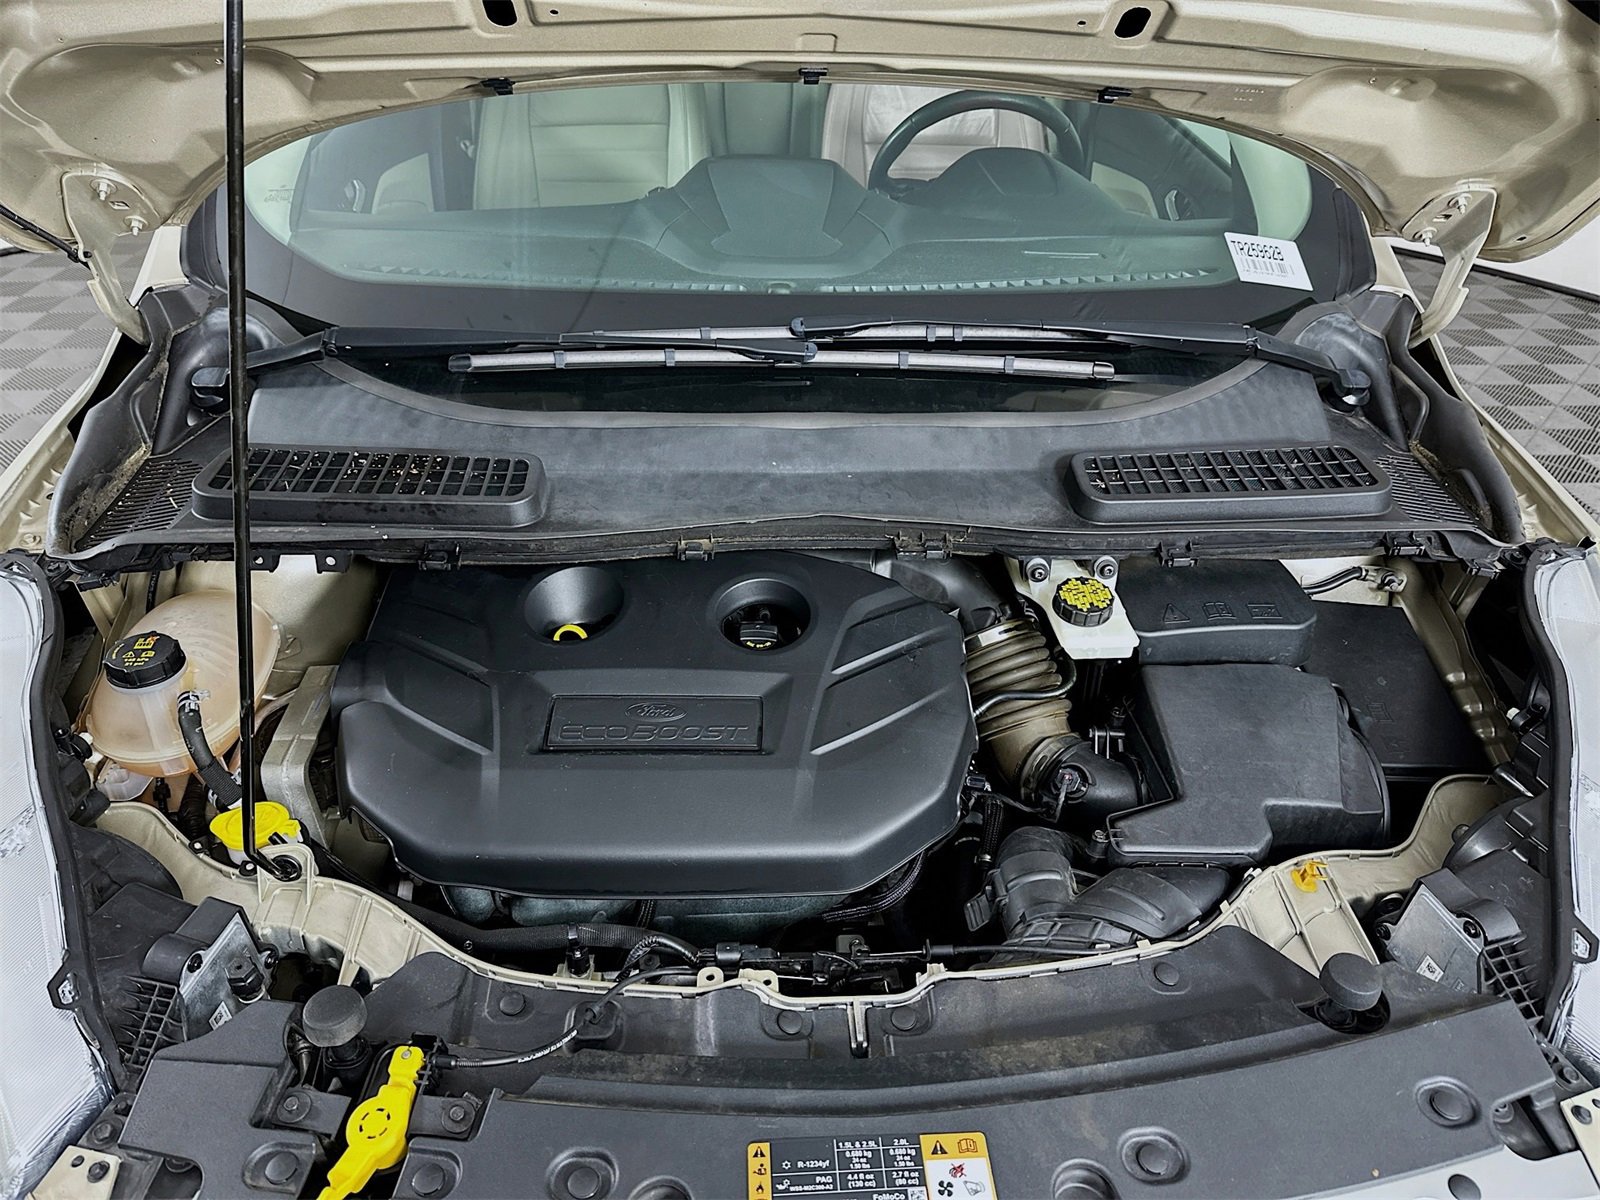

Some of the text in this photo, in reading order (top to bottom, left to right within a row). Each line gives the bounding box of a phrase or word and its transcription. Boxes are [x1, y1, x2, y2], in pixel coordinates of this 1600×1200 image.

[559, 725, 749, 742] ECOBOOST
[863, 1150, 873, 1158] kg
[907, 1148, 916, 1156] kg
[797, 1159, 830, 1169] R-1234yf
[815, 1175, 833, 1184] PAG
